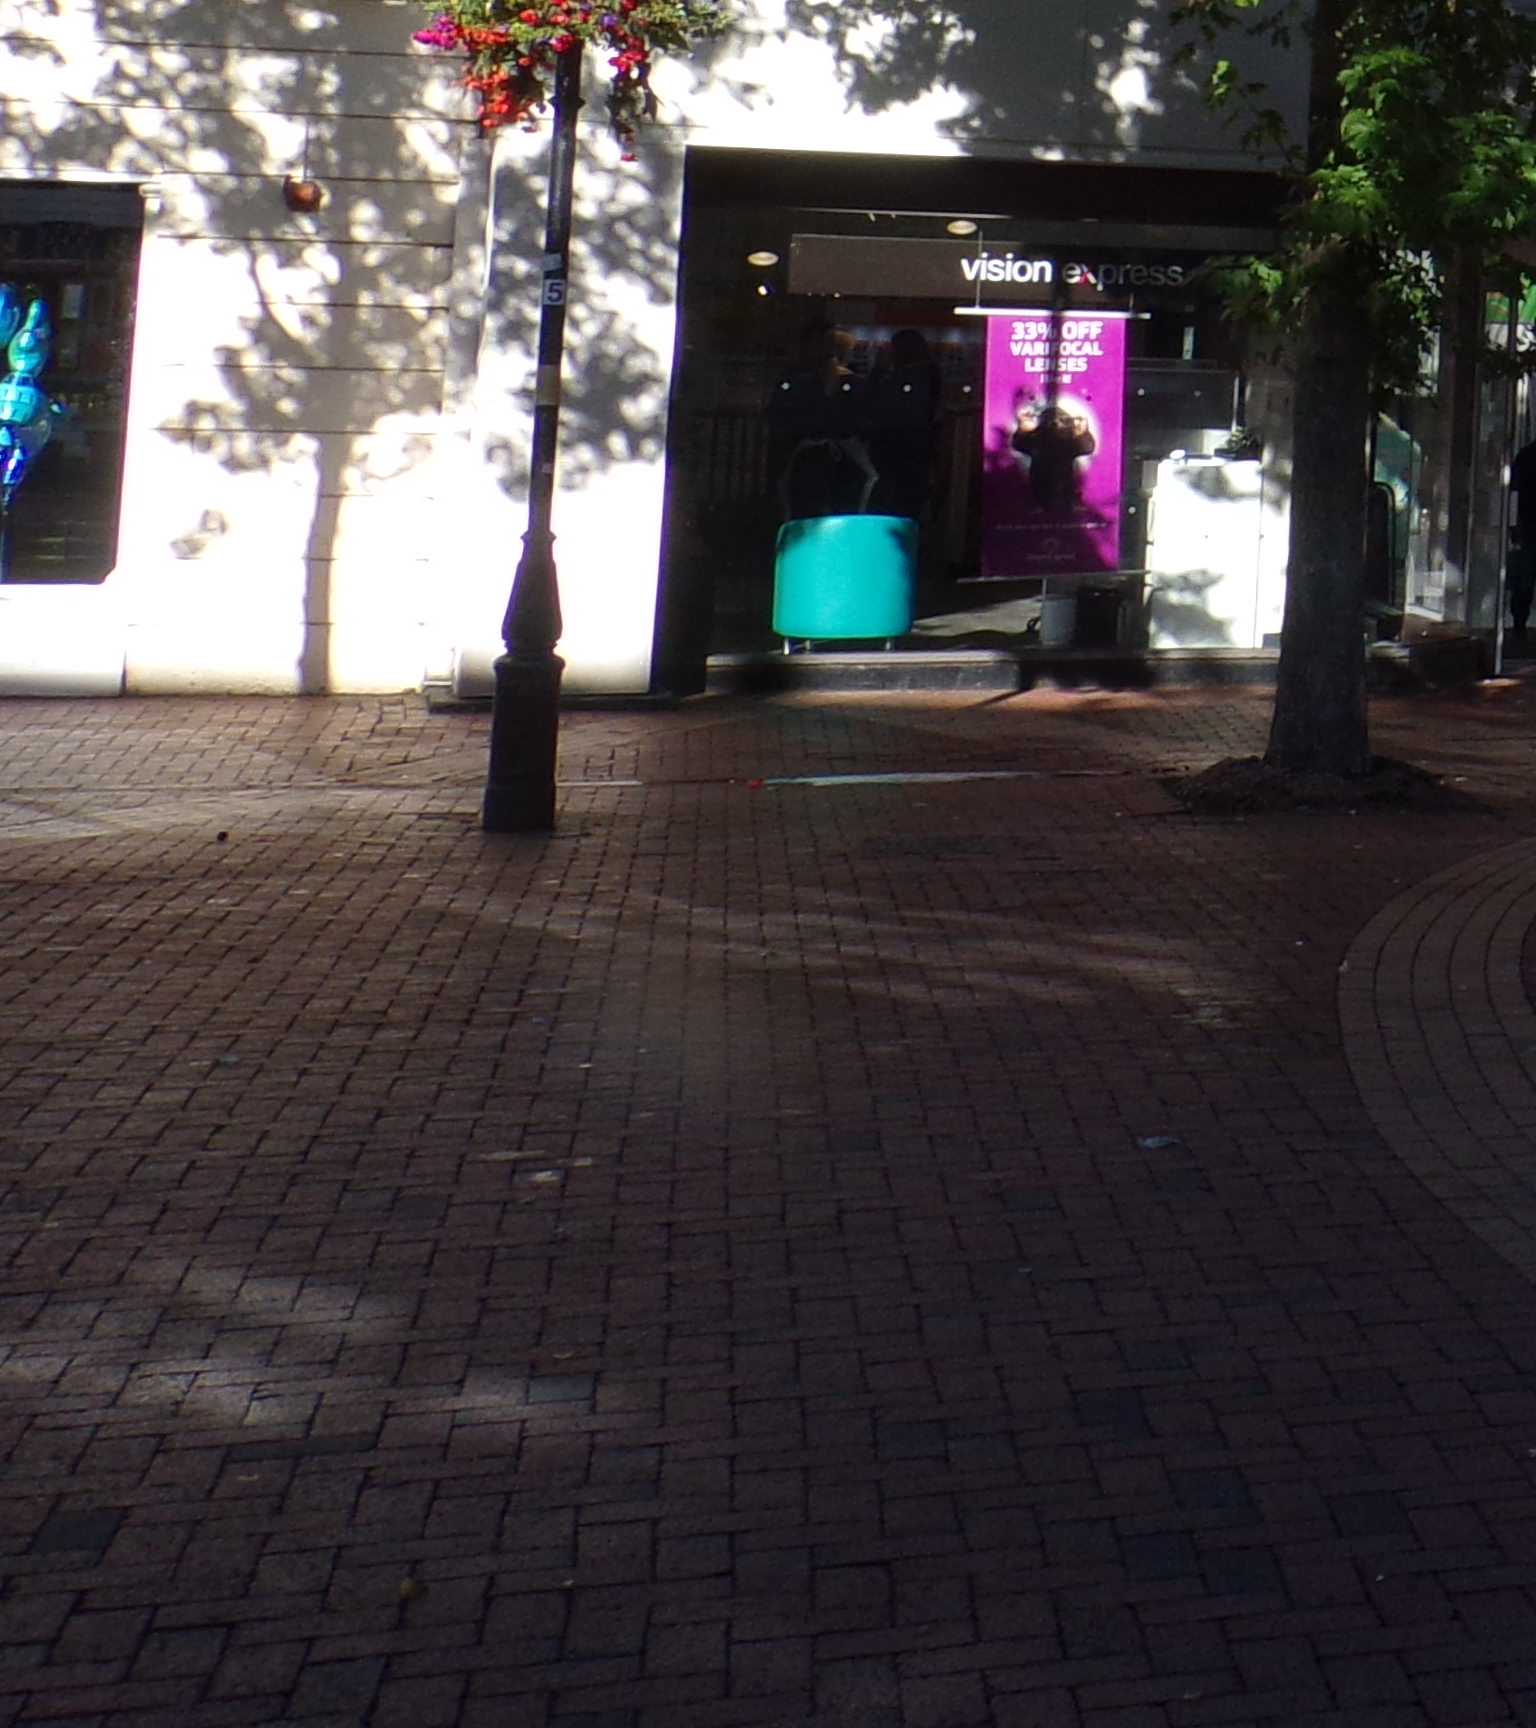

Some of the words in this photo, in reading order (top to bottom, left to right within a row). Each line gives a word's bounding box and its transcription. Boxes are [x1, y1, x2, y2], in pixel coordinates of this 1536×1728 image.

[961, 252, 1053, 282] vision
[1062, 261, 1184, 292] express
[547, 282, 563, 302] 5
[1011, 321, 1057, 340] 33%
[1061, 321, 1103, 340] OFF
[1010, 341, 1104, 356] VARIFOCAL
